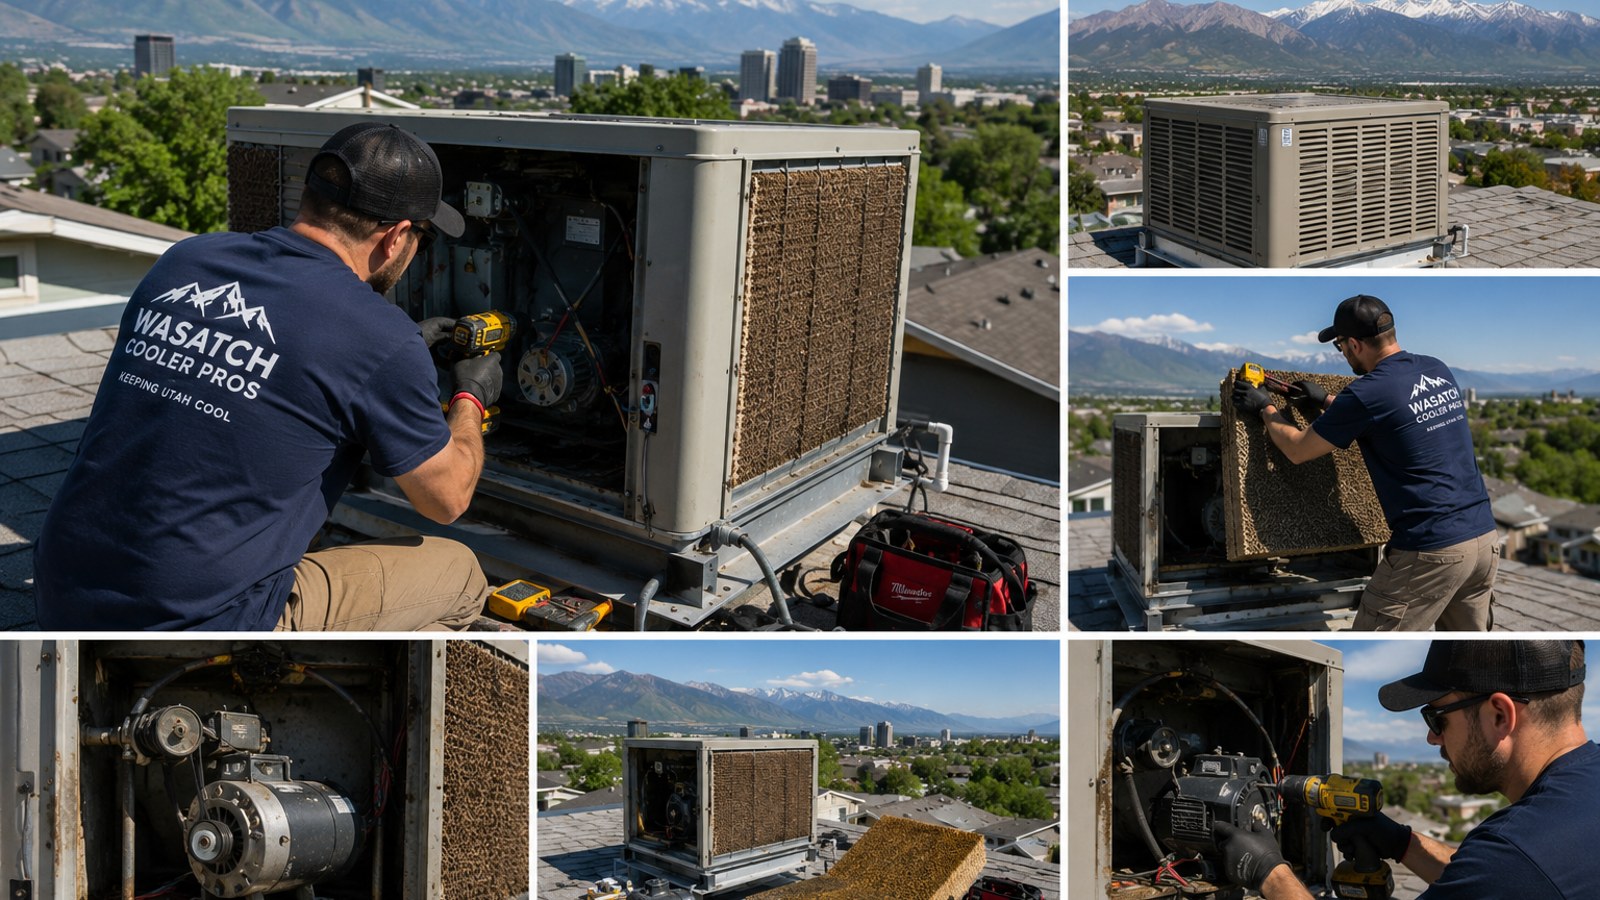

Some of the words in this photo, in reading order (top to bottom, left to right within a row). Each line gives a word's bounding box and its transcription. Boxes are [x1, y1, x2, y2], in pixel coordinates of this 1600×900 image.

[125, 338, 195, 374] COOLER
[197, 362, 261, 400] PROS
[133, 307, 280, 379] WASATCH
[118, 371, 159, 394] KEEPING
[161, 387, 192, 406] UTAH
[194, 400, 231, 423] COOL
